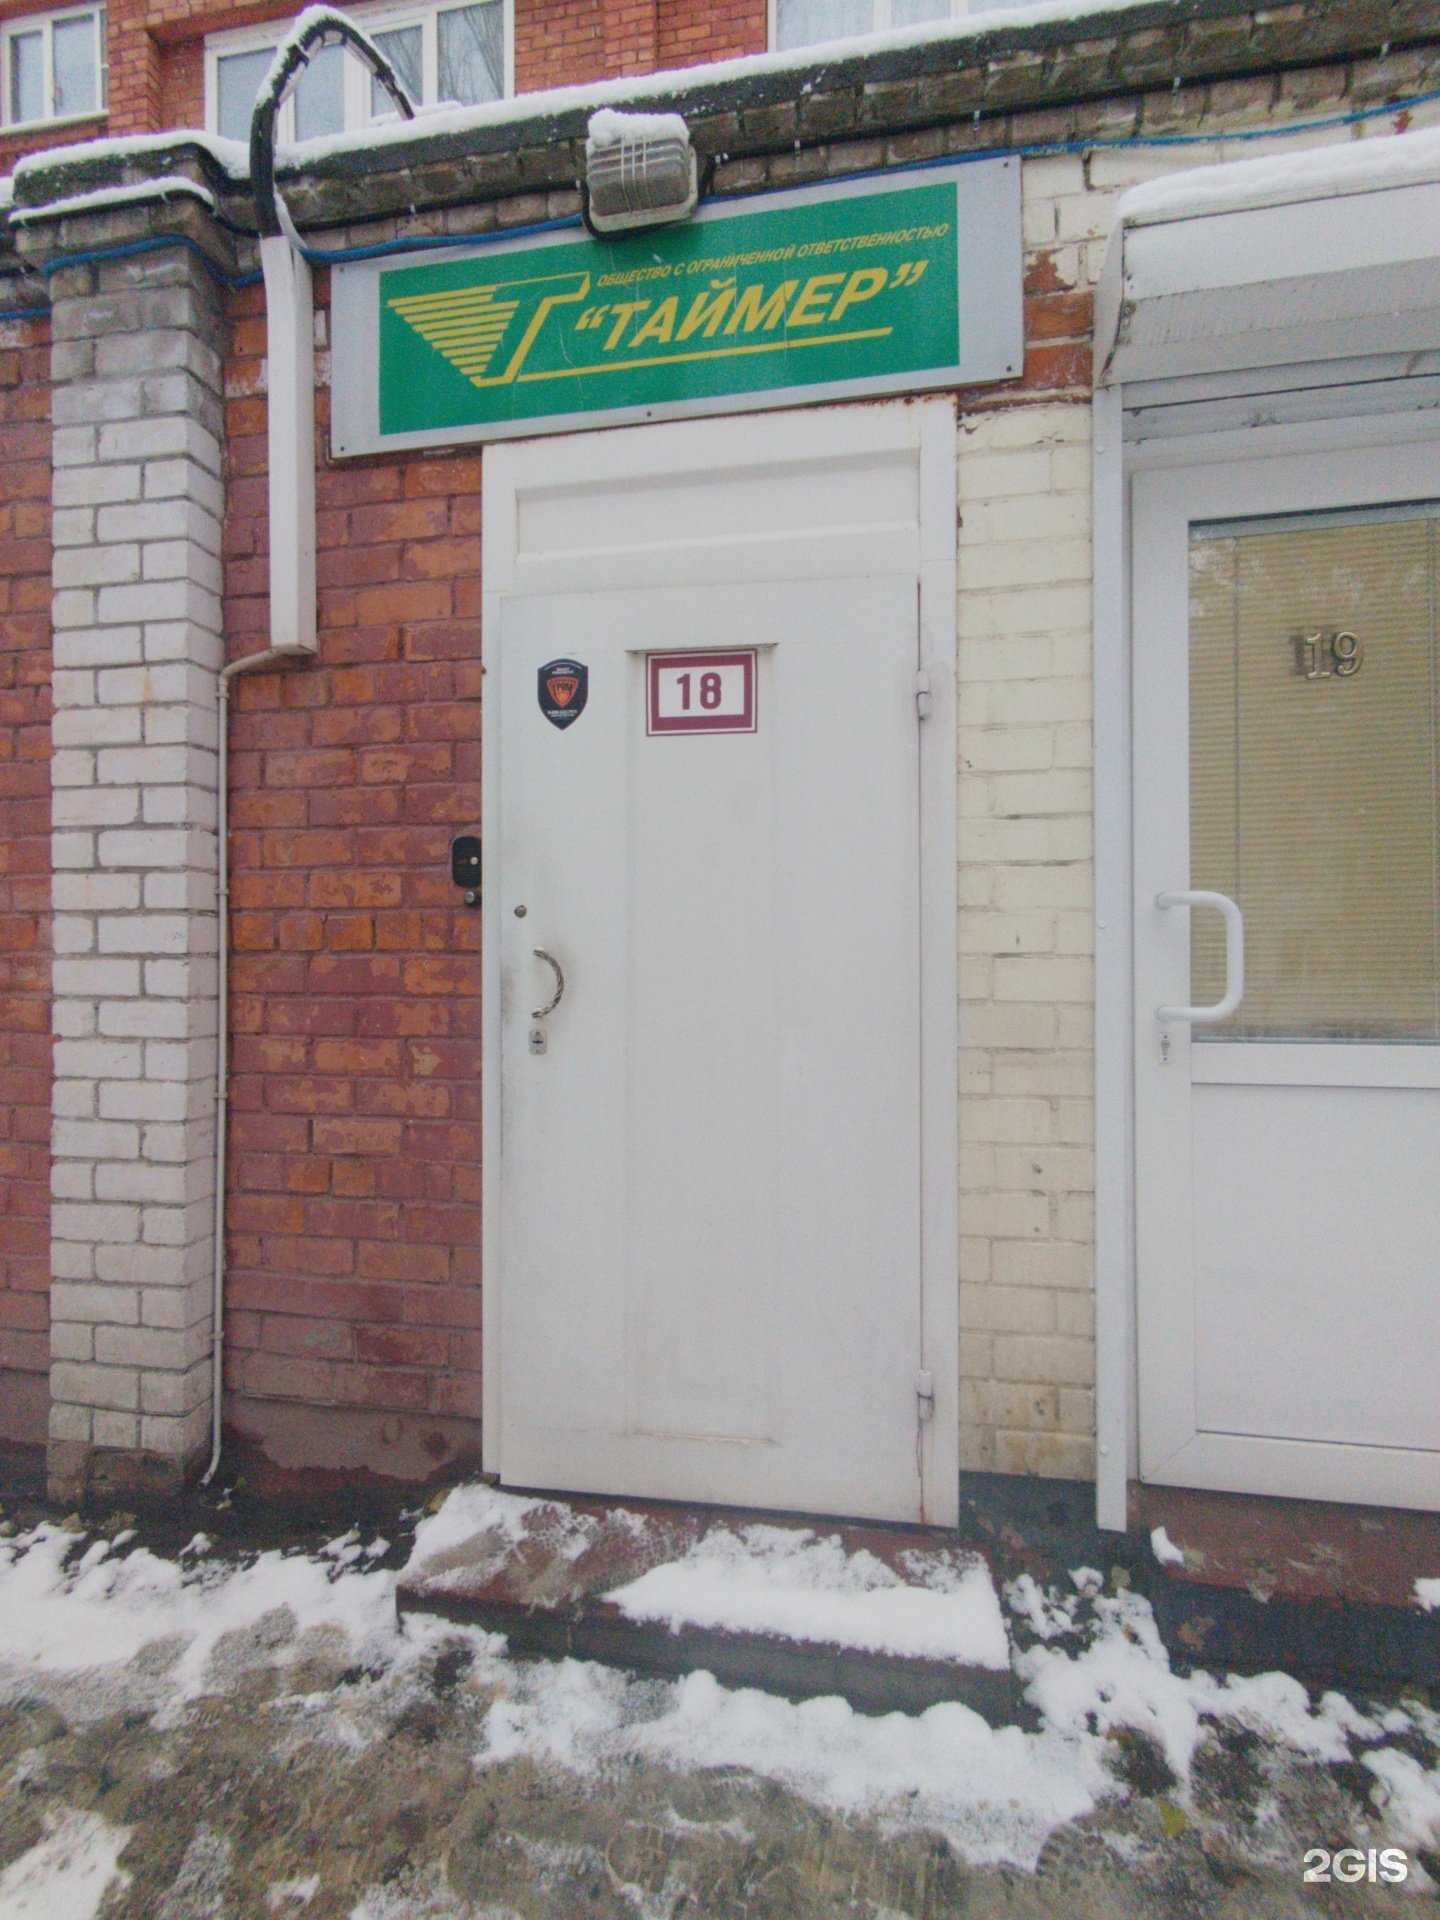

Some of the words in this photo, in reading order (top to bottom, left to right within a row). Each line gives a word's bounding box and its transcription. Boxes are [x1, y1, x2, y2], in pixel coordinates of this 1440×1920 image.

[597, 263, 672, 287] ОБЩЕСТВО
[673, 262, 686, 276] С
[686, 244, 798, 274] ОГРАНИЧЕННОЙ
[797, 222, 950, 258] ОТВЕТСТВЕННОСТЬЮ
[1305, 631, 1362, 679] 19
[676, 672, 722, 710] 18
